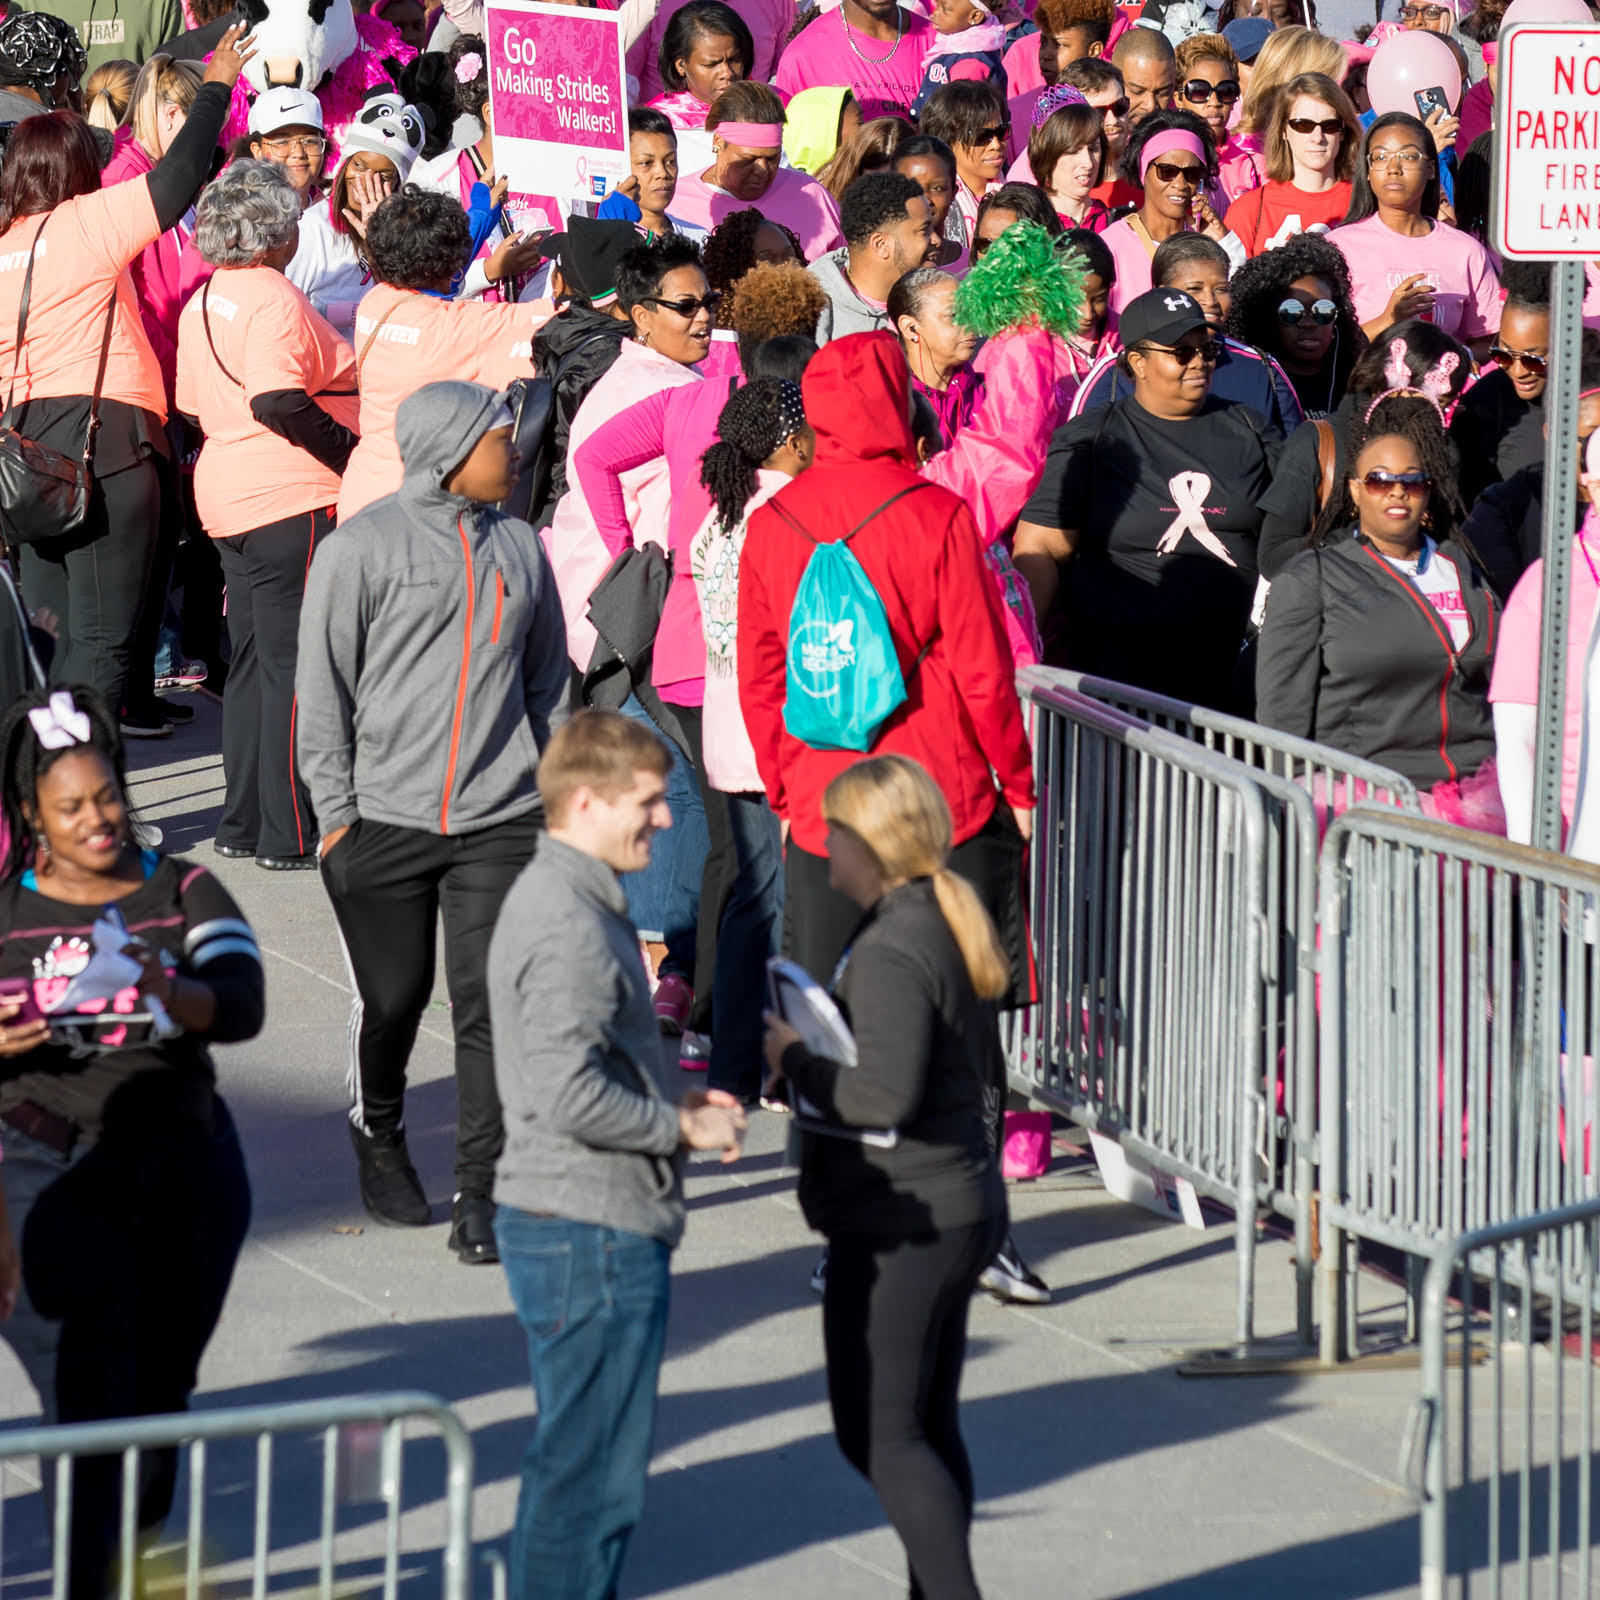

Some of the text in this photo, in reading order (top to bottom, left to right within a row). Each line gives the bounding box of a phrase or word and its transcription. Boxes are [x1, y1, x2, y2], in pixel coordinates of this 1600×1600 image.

[503, 27, 536, 66] Go
[496, 66, 609, 104] Making Strides
[557, 105, 616, 134] Walkers!
